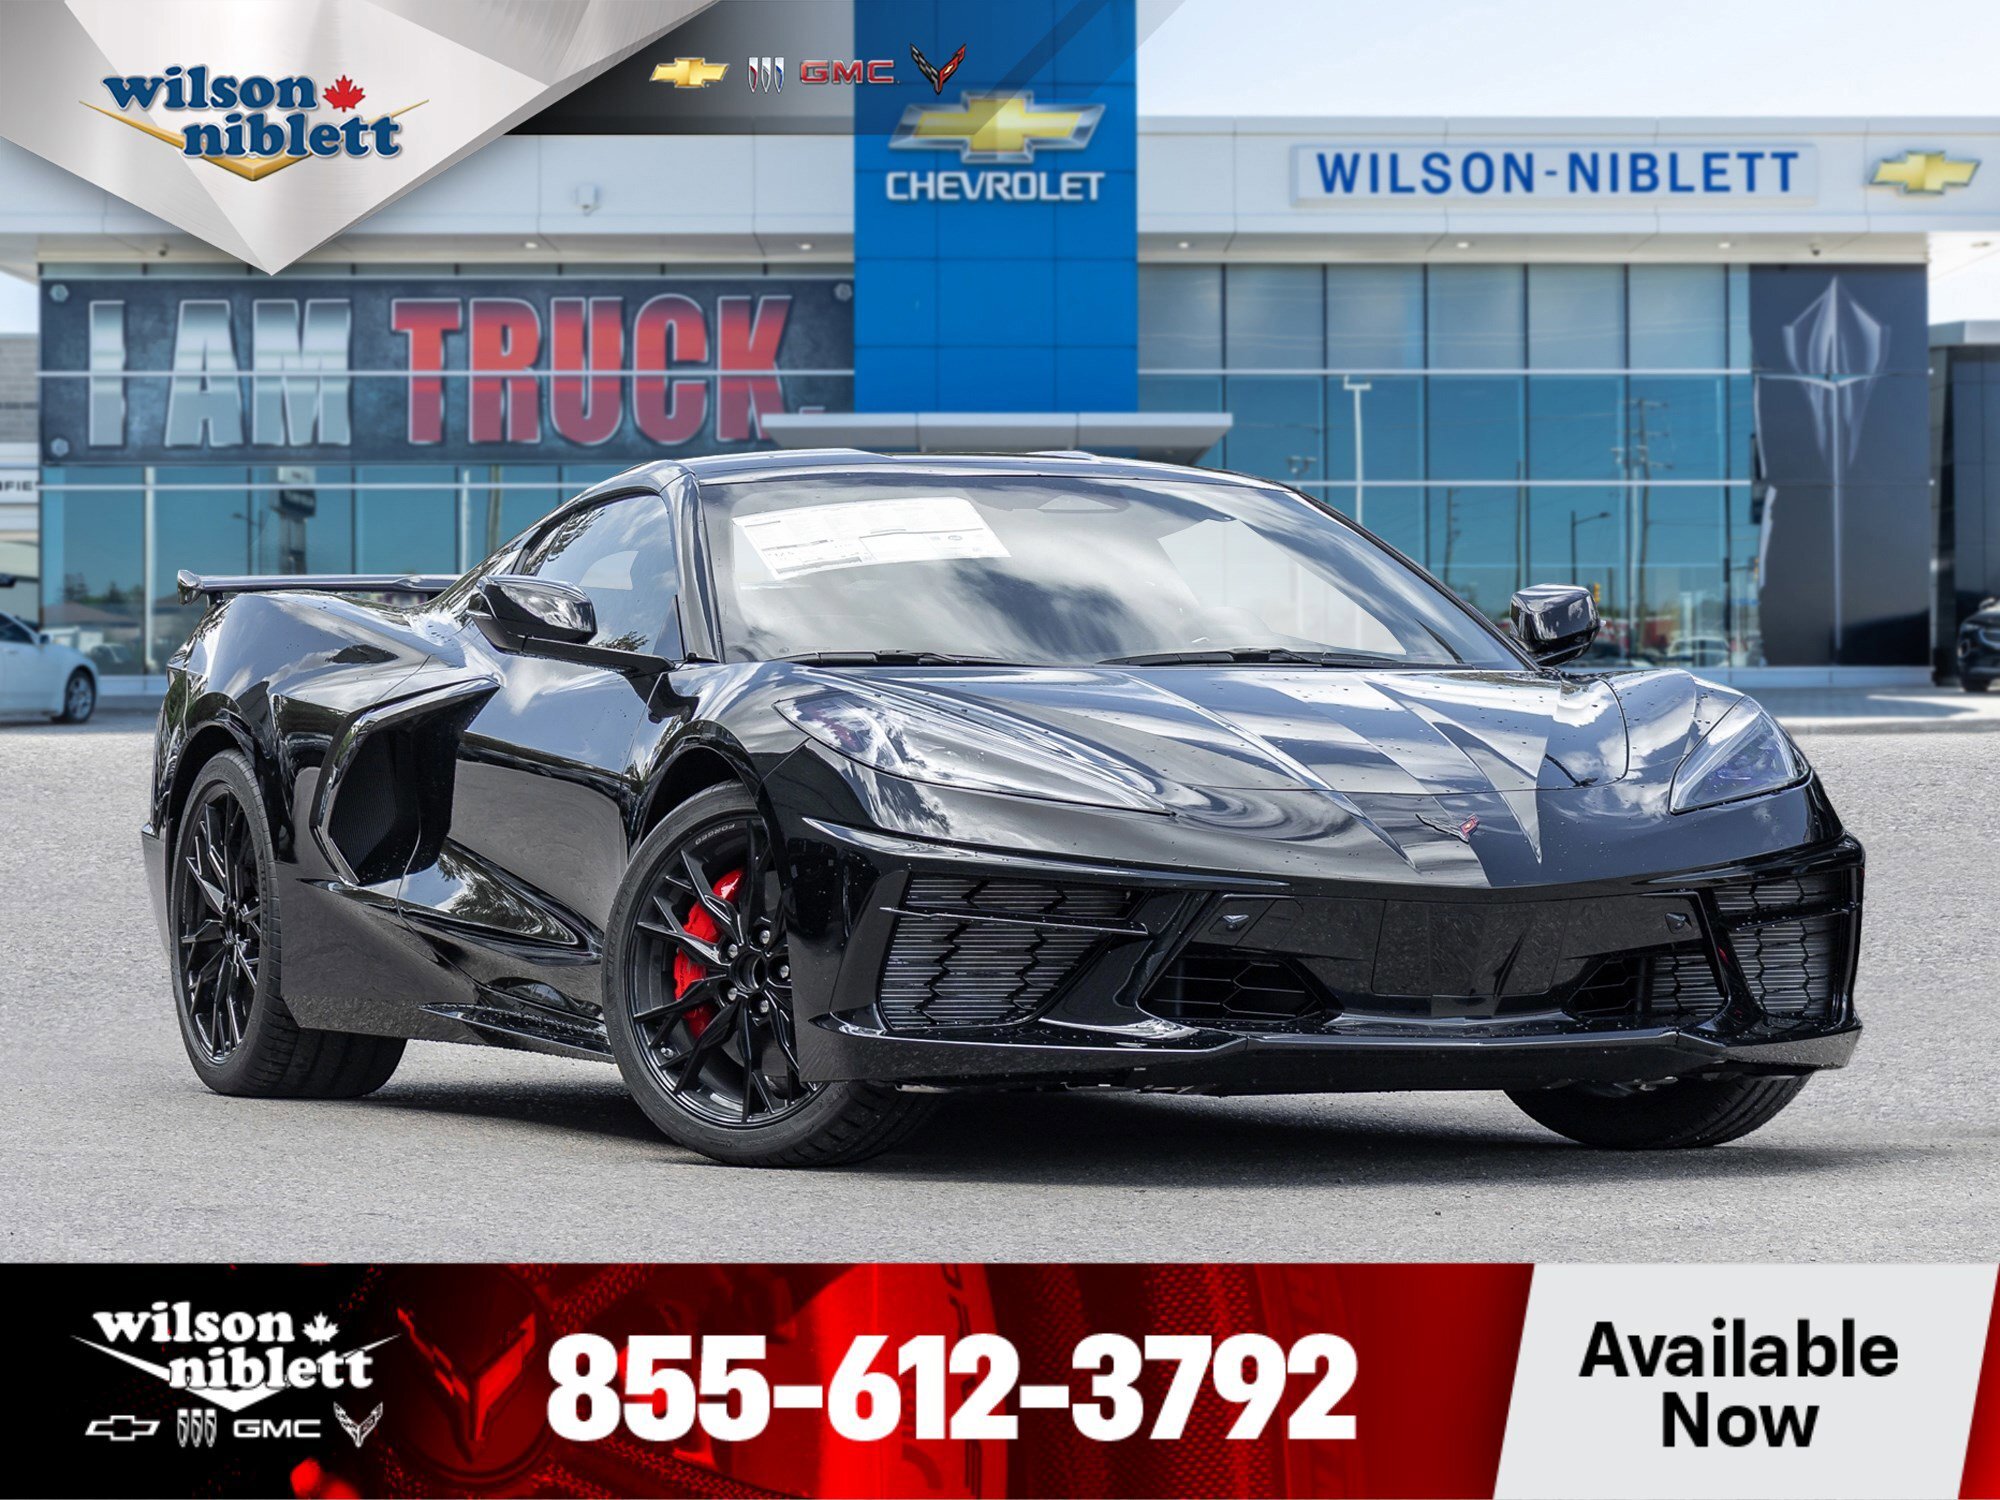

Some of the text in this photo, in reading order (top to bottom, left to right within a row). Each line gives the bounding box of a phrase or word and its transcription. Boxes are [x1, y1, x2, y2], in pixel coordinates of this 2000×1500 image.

[886, 171, 1105, 201] CHEVROLET
[1316, 151, 1799, 194] WILSON-NIBLETT
[88, 293, 825, 447] I AM TRUCK
